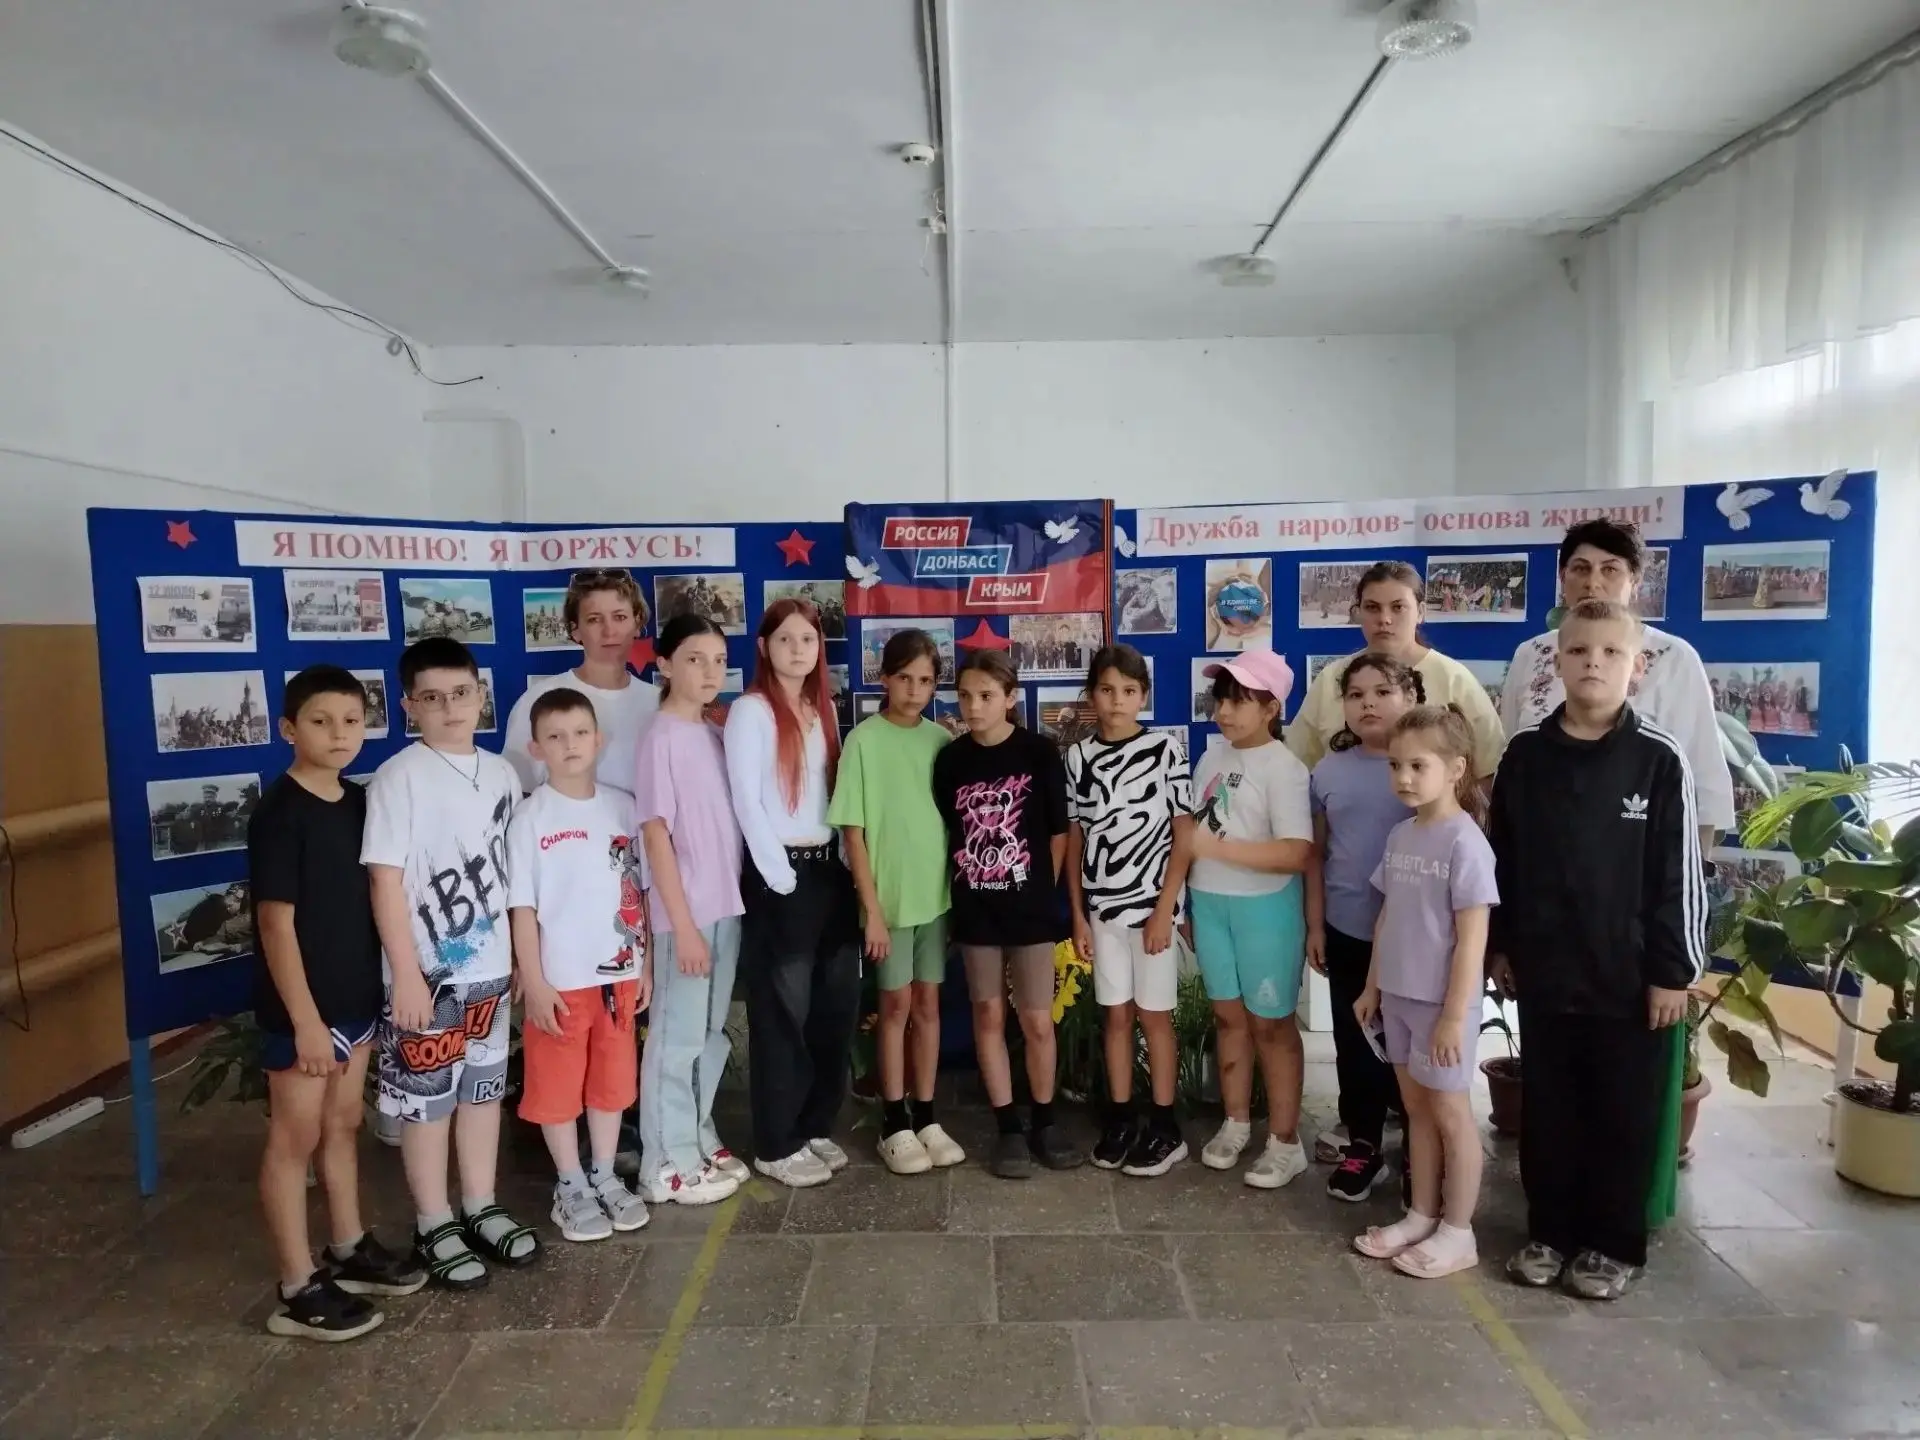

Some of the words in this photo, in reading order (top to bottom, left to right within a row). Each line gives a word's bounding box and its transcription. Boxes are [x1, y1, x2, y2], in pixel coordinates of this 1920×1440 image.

[894, 525, 960, 541] РОССИЯ
[1145, 515, 1260, 546] Дружба
[1423, 507, 1531, 531] основа
[272, 531, 297, 558] Я
[309, 532, 467, 563] ПОМНЮ!
[488, 538, 510, 562] Я
[520, 535, 703, 563] ГОРЖУСЬ!
[922, 554, 998, 571] ДОНБАСС
[980, 582, 1032, 598] КРЫМ
[540, 828, 589, 851] CHAMPION
